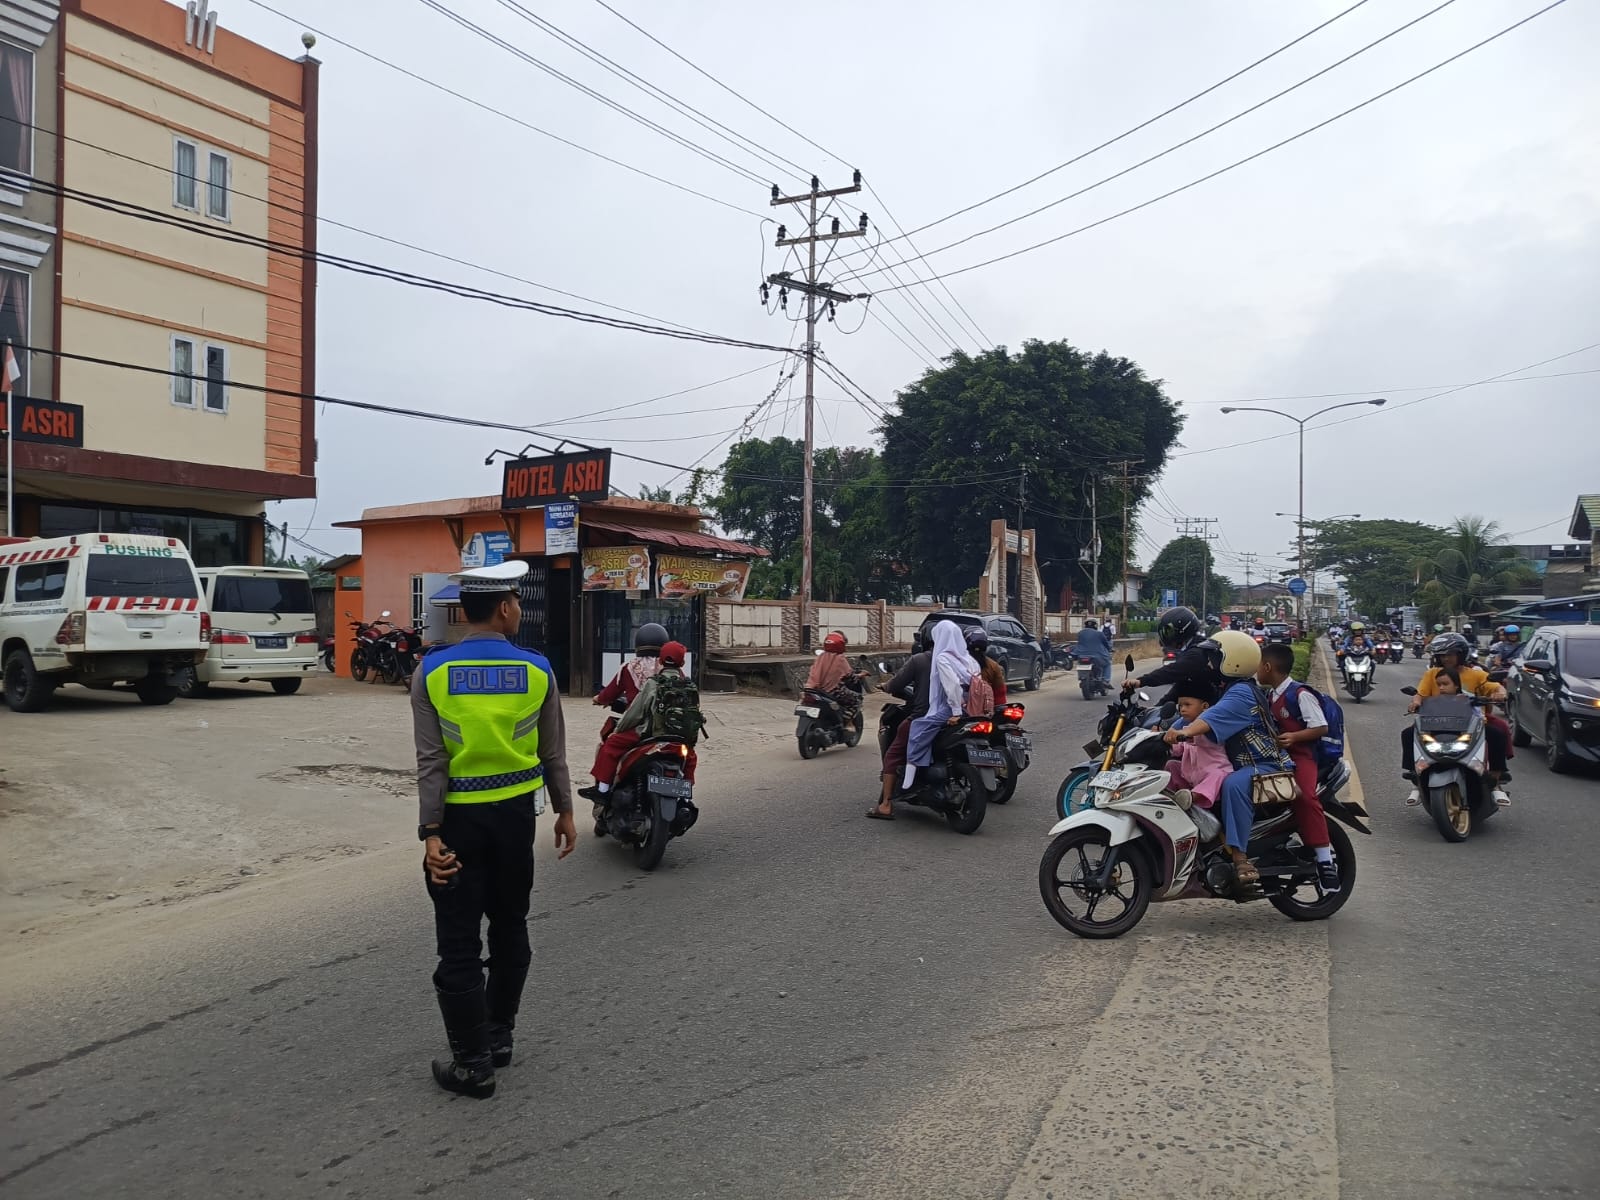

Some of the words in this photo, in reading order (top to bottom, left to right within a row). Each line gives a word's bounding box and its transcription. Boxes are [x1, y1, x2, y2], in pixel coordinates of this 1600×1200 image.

[22, 405, 75, 438] ASRI
[506, 464, 557, 498] HOTEL
[562, 459, 605, 494] ASRI
[105, 544, 173, 559] PUSLING
[600, 558, 625, 570] ASRI
[660, 556, 686, 571] AYAM
[682, 569, 713, 581] ASRI
[452, 669, 525, 691] POLISI
[650, 775, 659, 784] KB
